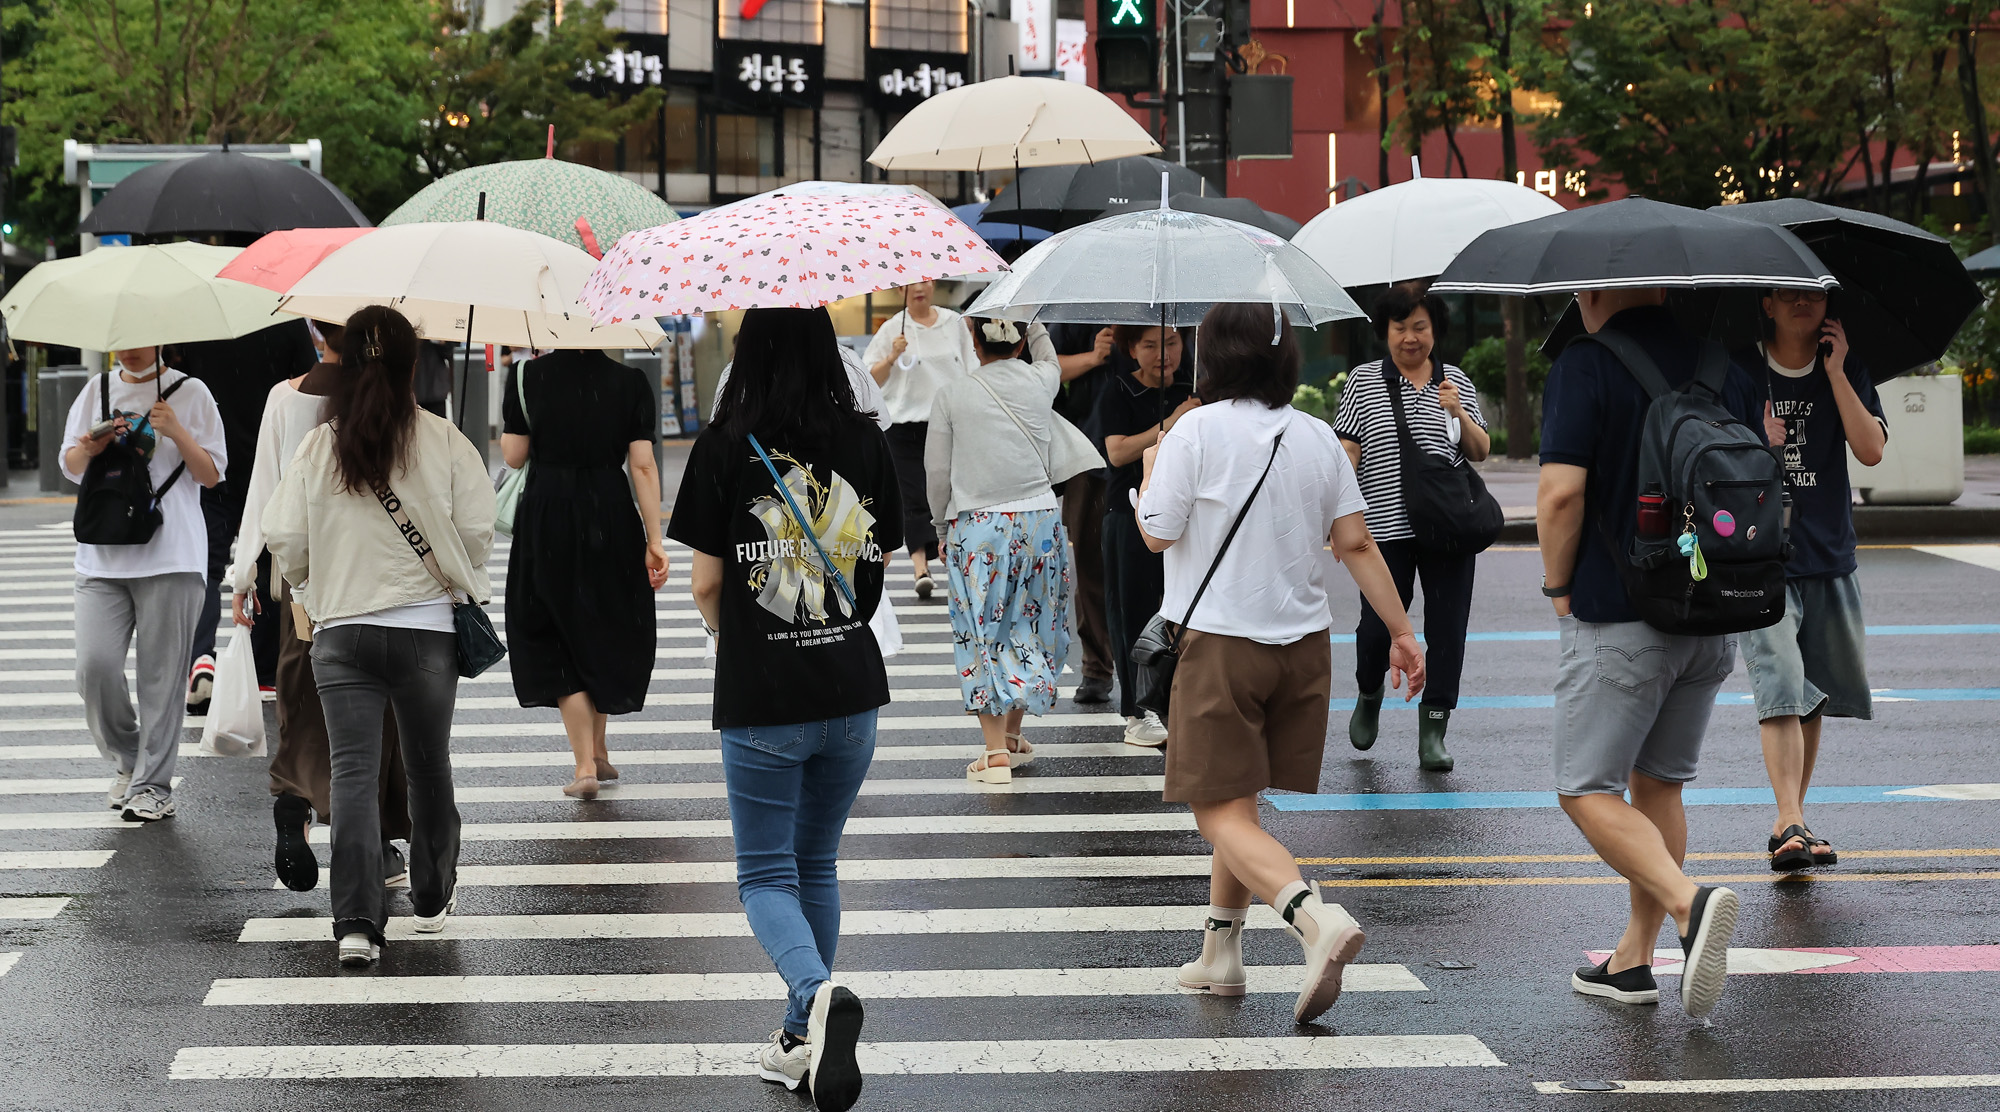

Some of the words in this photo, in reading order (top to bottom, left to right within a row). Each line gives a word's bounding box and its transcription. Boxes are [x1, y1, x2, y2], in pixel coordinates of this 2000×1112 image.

[739, 53, 809, 93] 청담동
[401, 519, 433, 557] FOR
[736, 538, 796, 563] FUTURE
[774, 632, 789, 640] LONG
[790, 631, 798, 639] AS
[802, 638, 821, 646] DREAM
